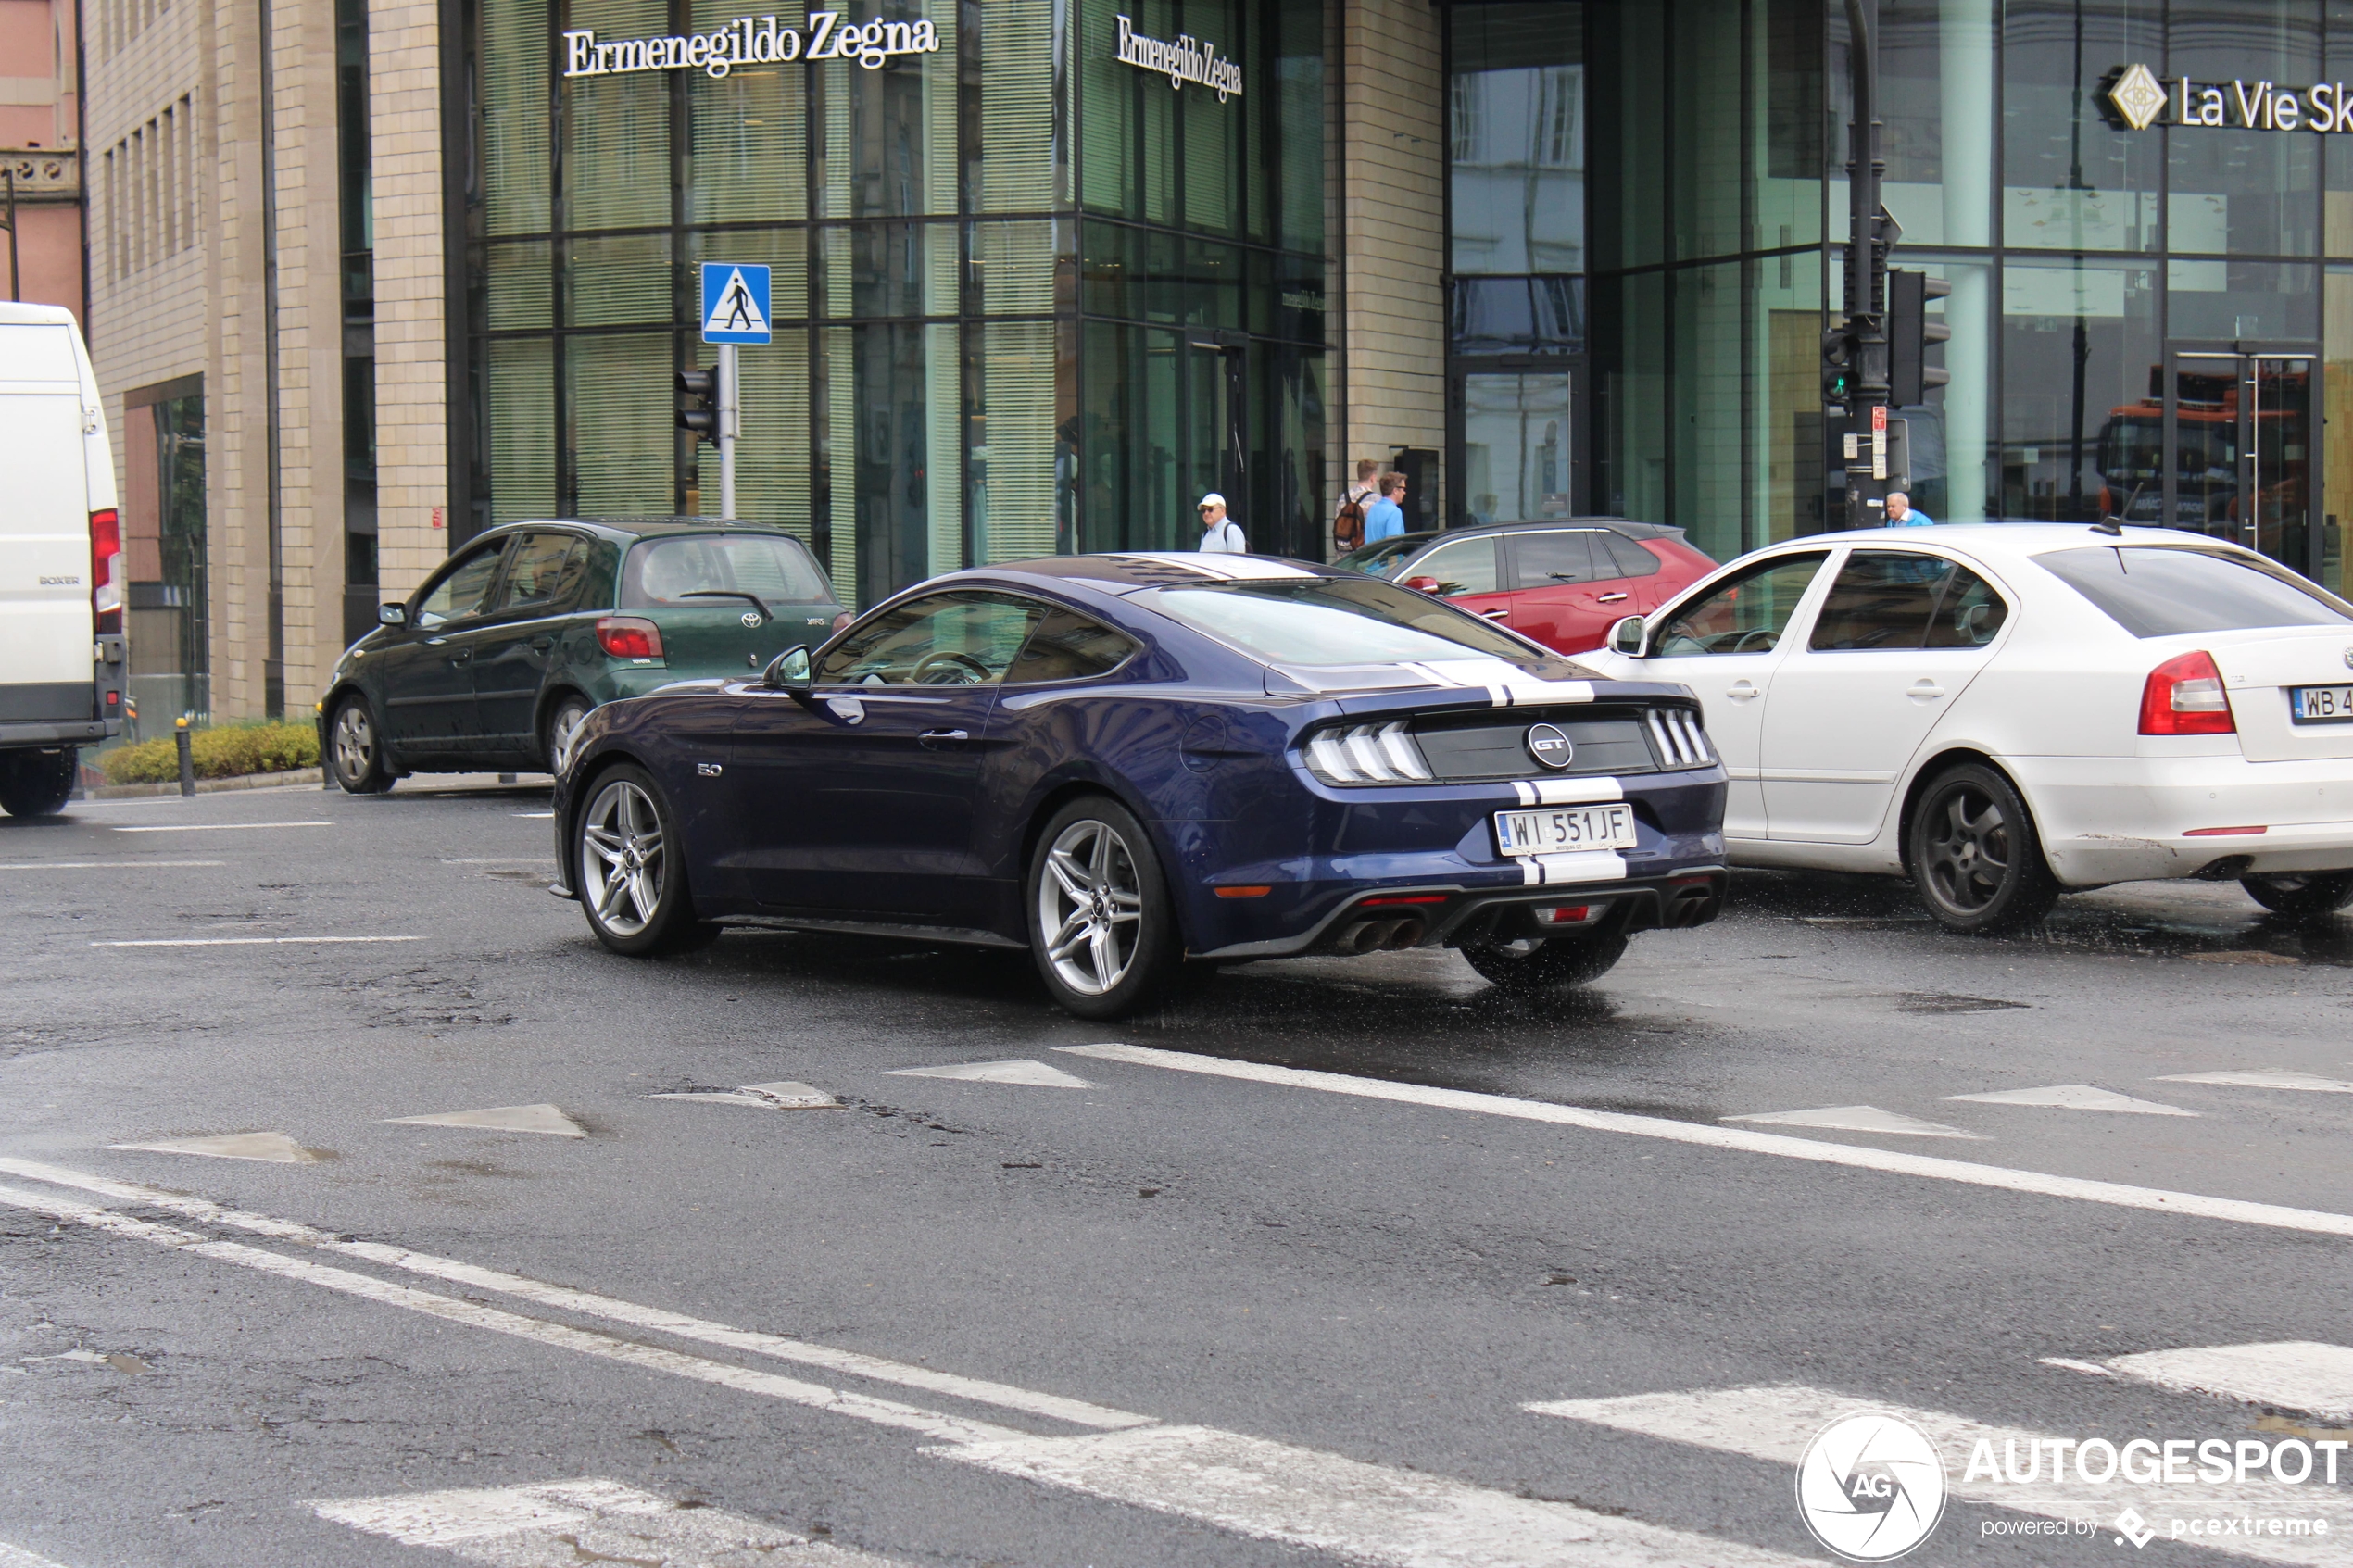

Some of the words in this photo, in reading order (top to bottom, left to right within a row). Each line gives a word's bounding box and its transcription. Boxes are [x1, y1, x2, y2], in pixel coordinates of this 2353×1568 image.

[563, 16, 801, 79] Ermenegildo
[805, 11, 940, 70] Zegna
[1116, 14, 1203, 90] Ermenegildo
[1203, 42, 1242, 104] Zegna
[2180, 76, 2223, 127] La
[2230, 79, 2299, 132] Vie
[2305, 81, 2353, 133] Sk
[39, 576, 80, 585] BOXER
[2306, 690, 2334, 716] WB
[2343, 689, 2353, 714] 4
[1534, 738, 1566, 751] GT
[1501, 835, 1510, 845] PL
[1512, 815, 1541, 846] WI
[1552, 809, 1623, 843] 551JF
